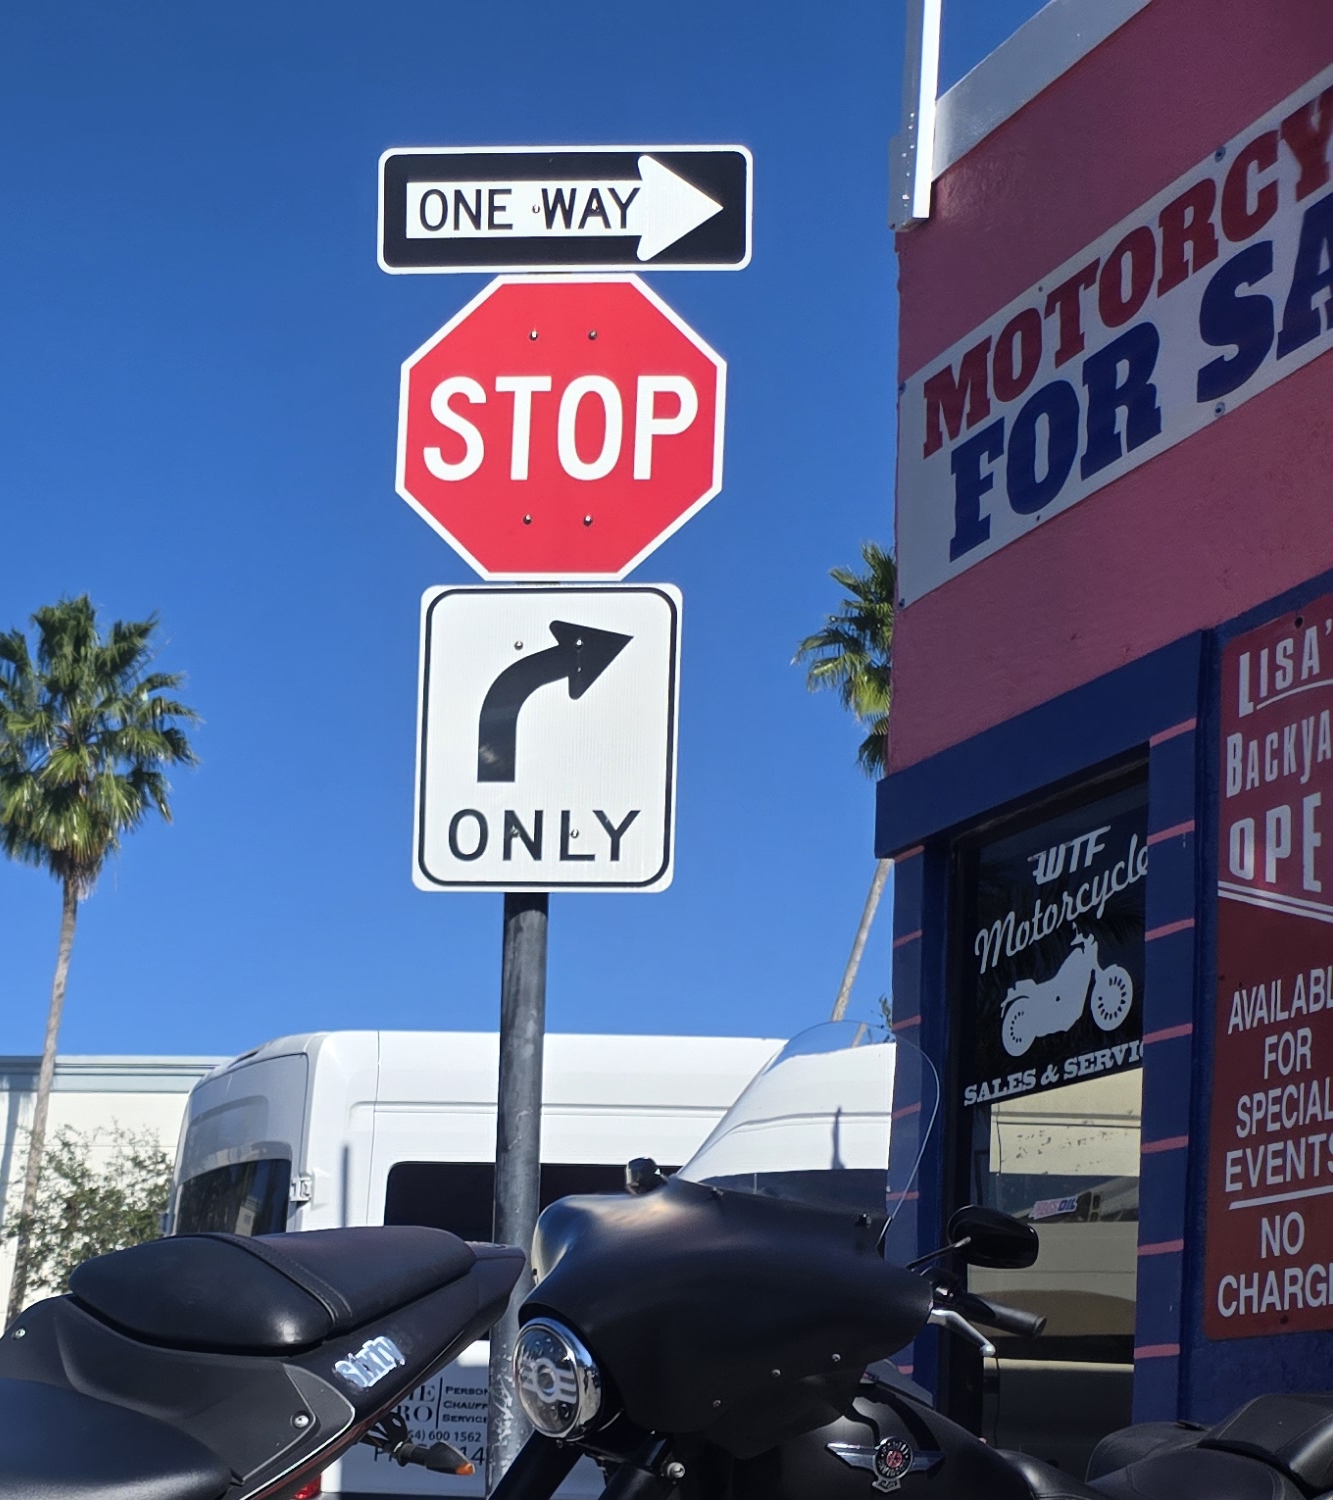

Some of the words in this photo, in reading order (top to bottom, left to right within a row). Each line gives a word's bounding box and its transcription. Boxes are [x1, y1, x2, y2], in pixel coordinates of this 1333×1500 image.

[419, 188, 513, 232] ONE
[541, 187, 641, 230] WAY
[423, 375, 699, 483] STOP
[949, 321, 1162, 563] FOR
[448, 808, 642, 862] ONLY
[1027, 825, 1111, 885] WTF
[1229, 792, 1322, 893] OPE
[964, 1069, 1036, 1107] SALES
[1040, 1063, 1060, 1086] &
[1063, 1040, 1144, 1080] SERVI
[1264, 1027, 1312, 1079] FOR
[1236, 1077, 1333, 1138] SPECIAL
[1261, 1211, 1305, 1259] NO
[428, 1430, 451, 1441] 600
[454, 1431, 482, 1443] 1562
